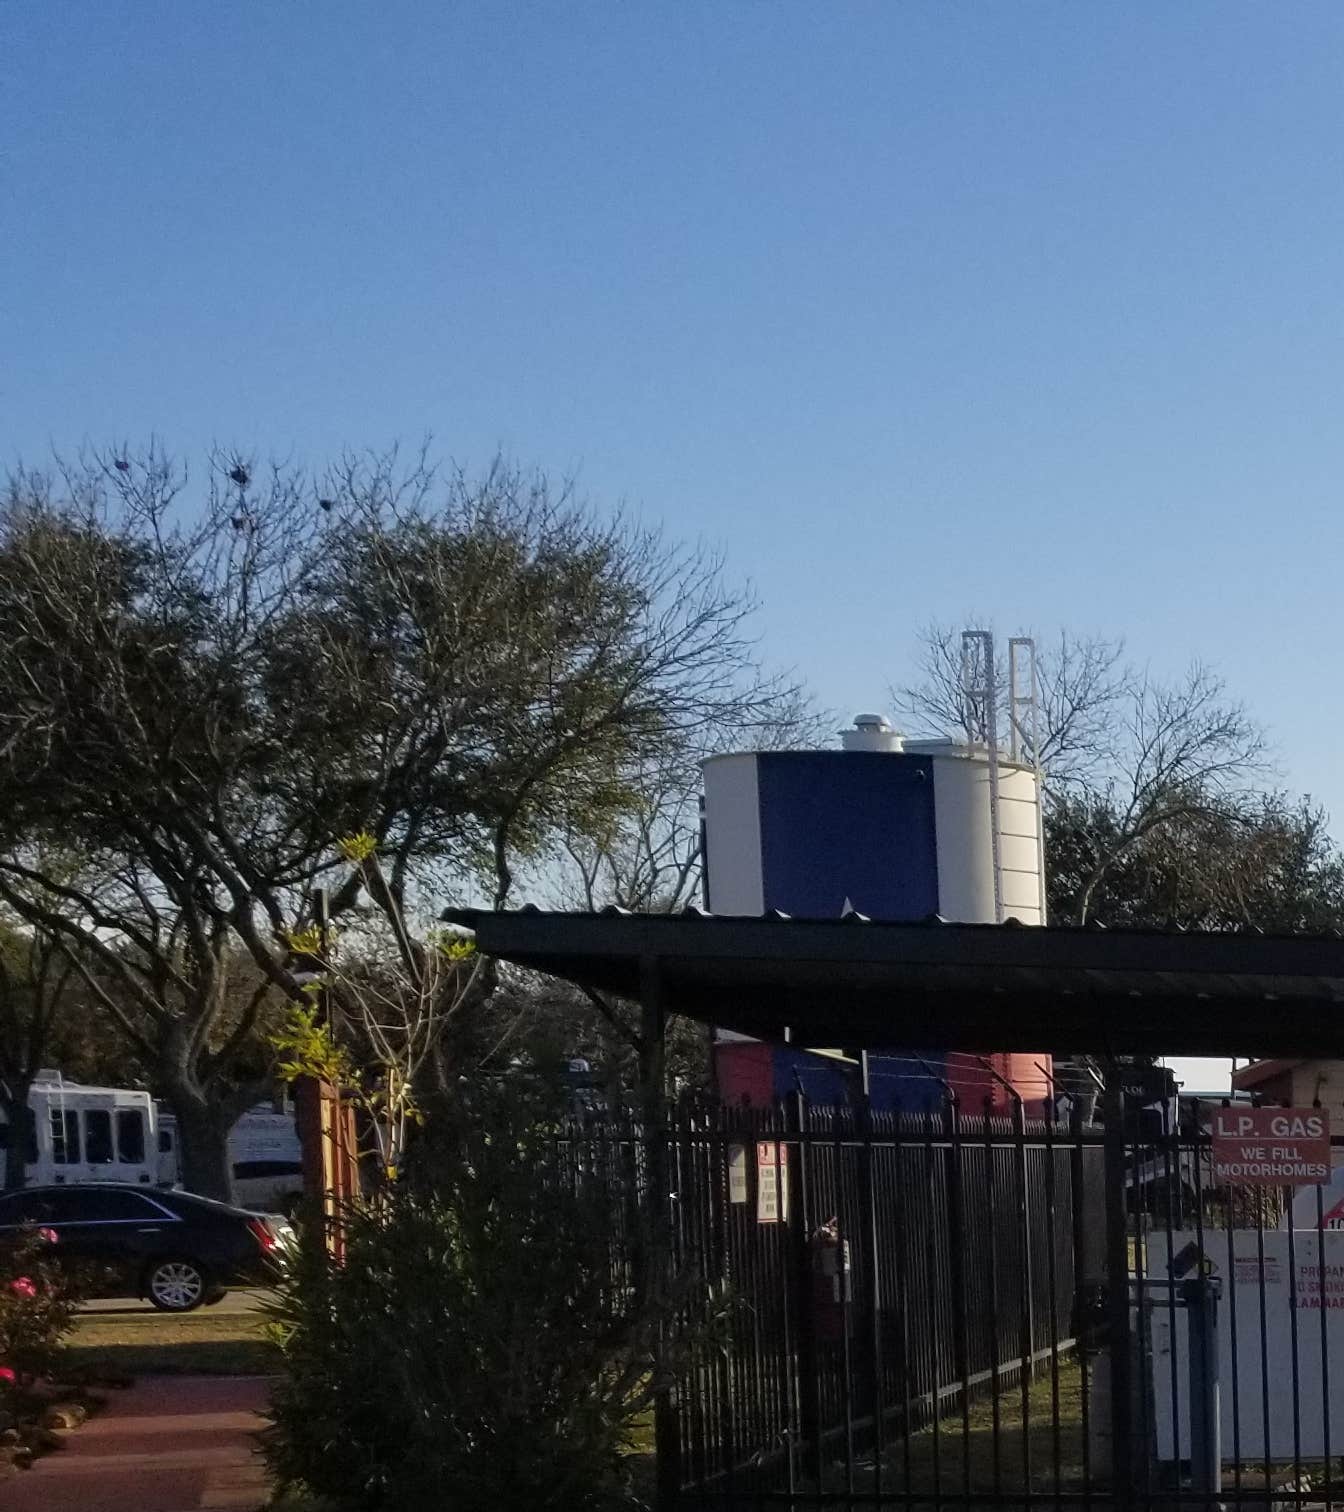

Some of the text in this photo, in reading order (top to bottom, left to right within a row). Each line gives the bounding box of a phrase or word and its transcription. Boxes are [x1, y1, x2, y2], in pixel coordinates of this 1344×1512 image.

[1217, 1115, 1324, 1138] L.P. GAS
[1241, 1147, 1303, 1161] WE FILL
[1216, 1162, 1328, 1177] MOTORHOMES
